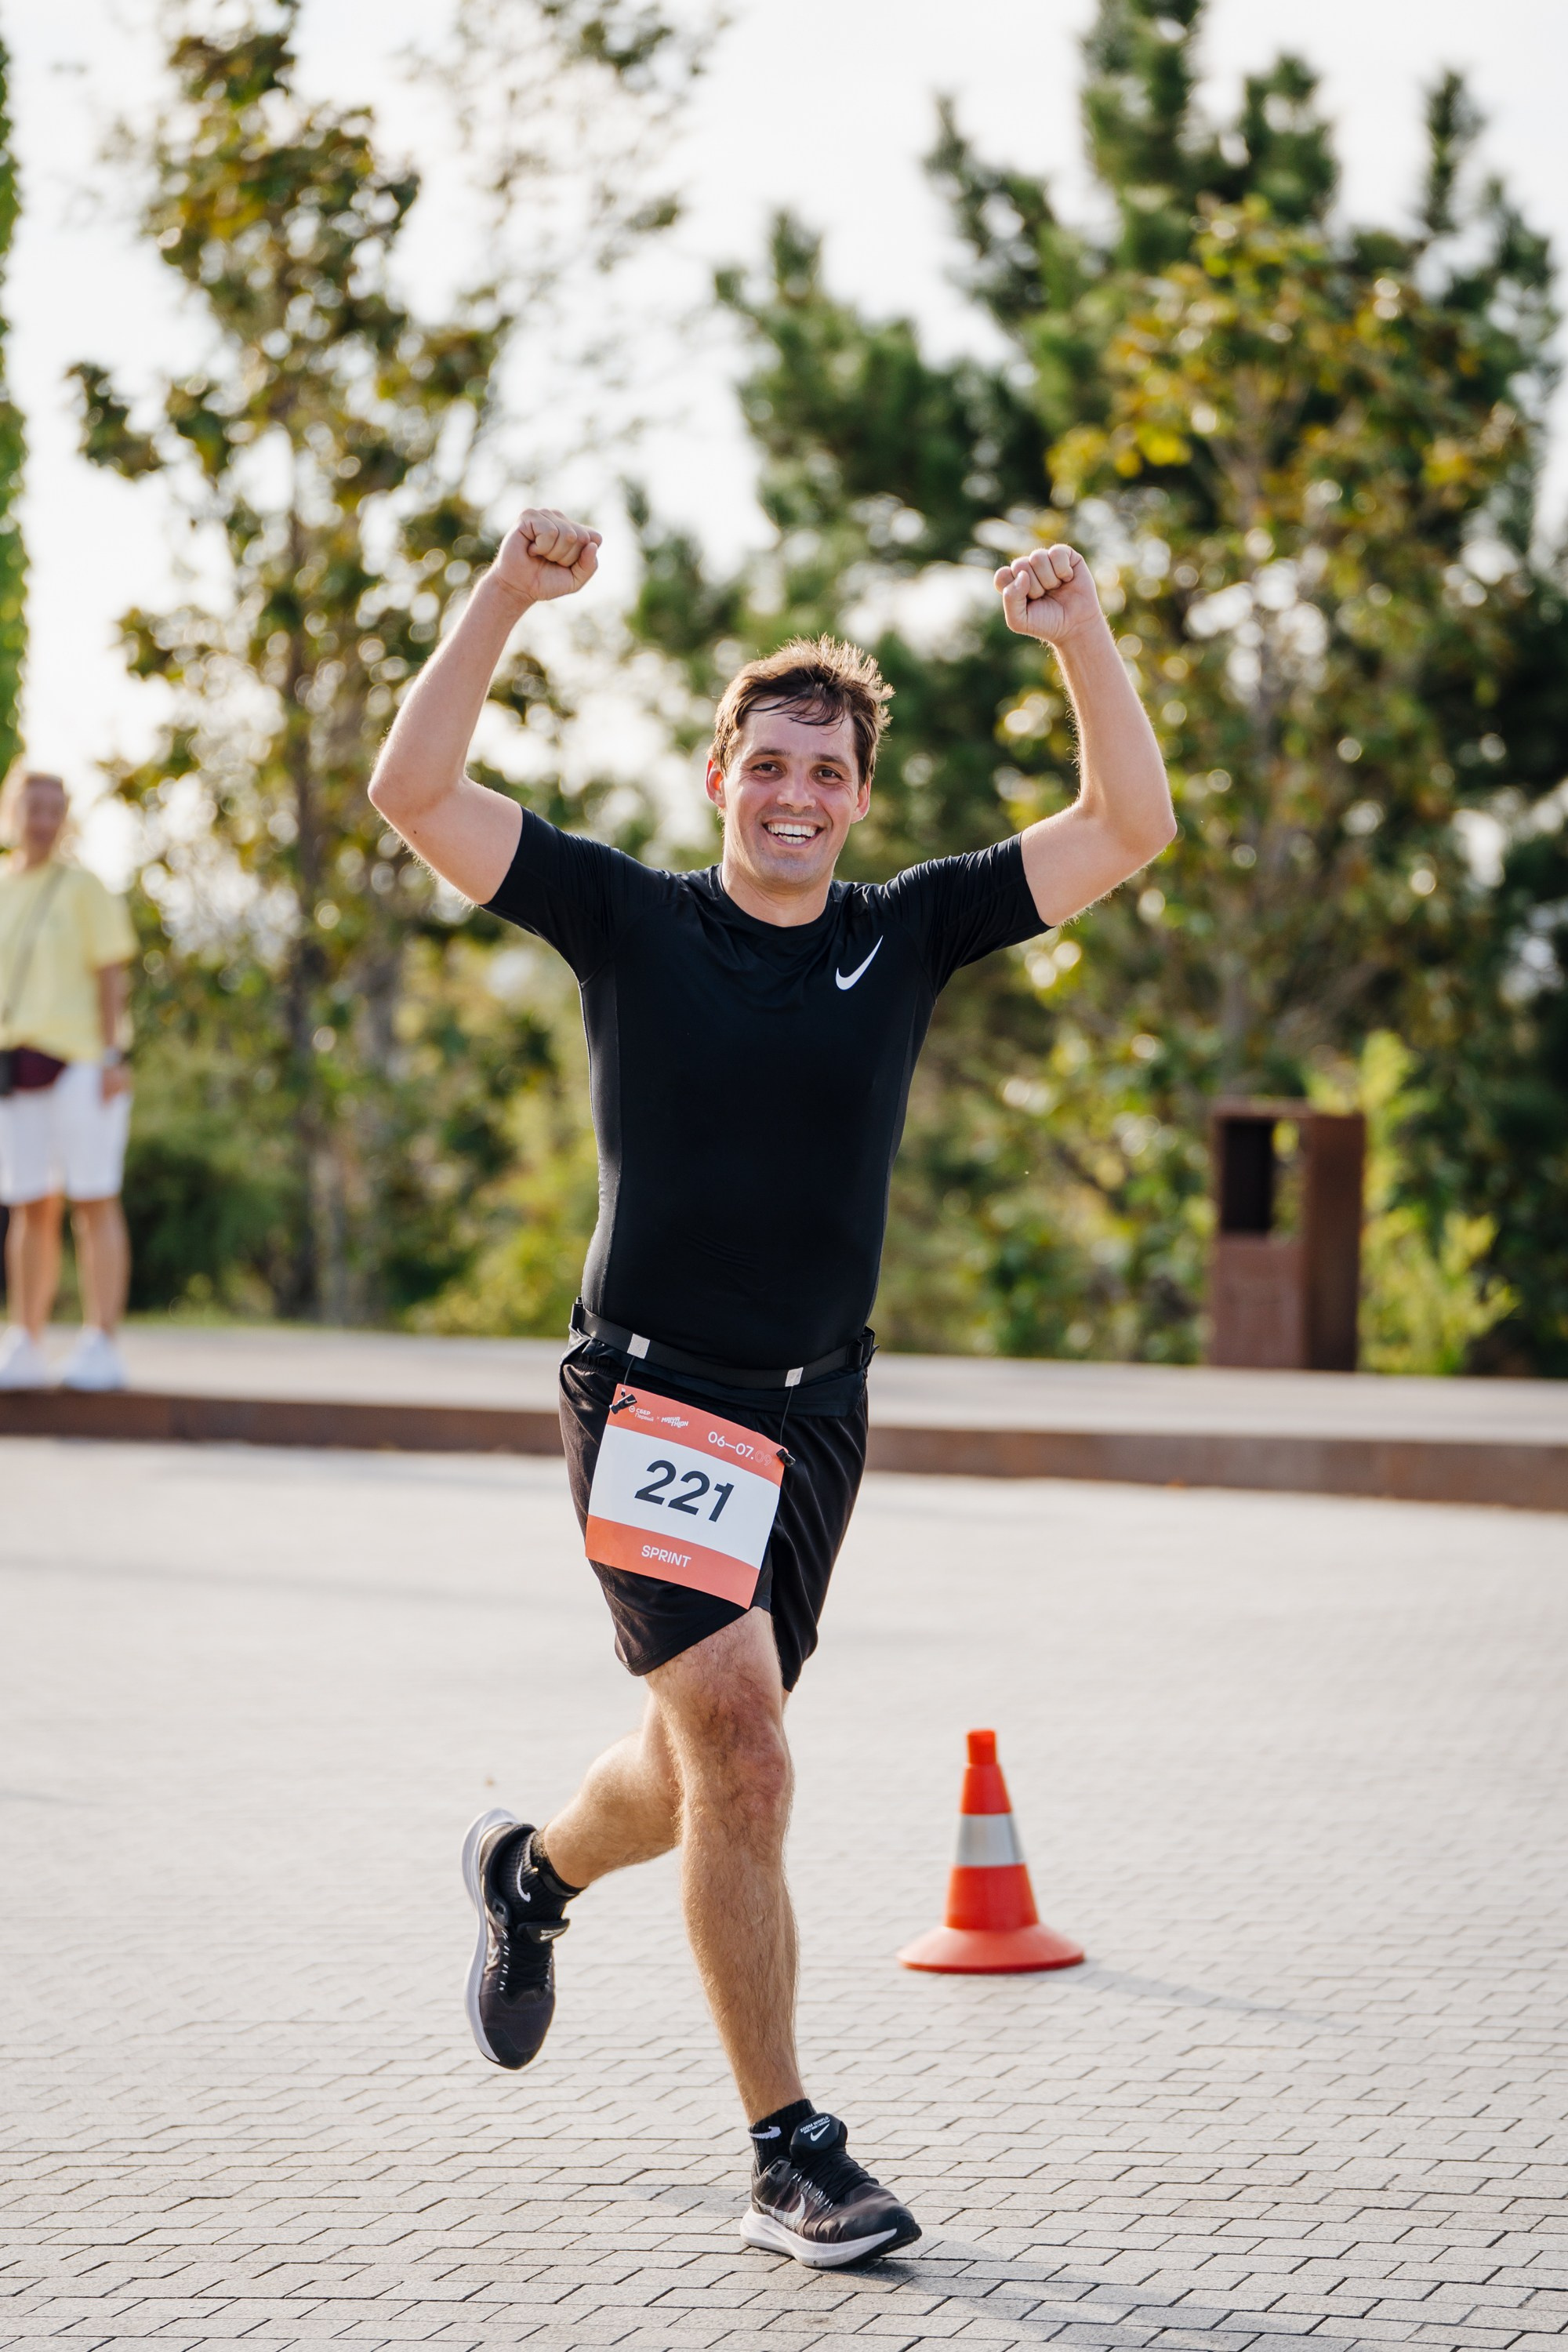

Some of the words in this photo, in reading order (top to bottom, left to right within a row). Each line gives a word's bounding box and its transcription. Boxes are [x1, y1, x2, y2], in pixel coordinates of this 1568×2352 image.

[635, 1413, 654, 1421] Первый
[634, 1459, 735, 1523] 221
[641, 1544, 691, 1568] SPRINT
[800, 2123, 813, 2132] ZOOM
